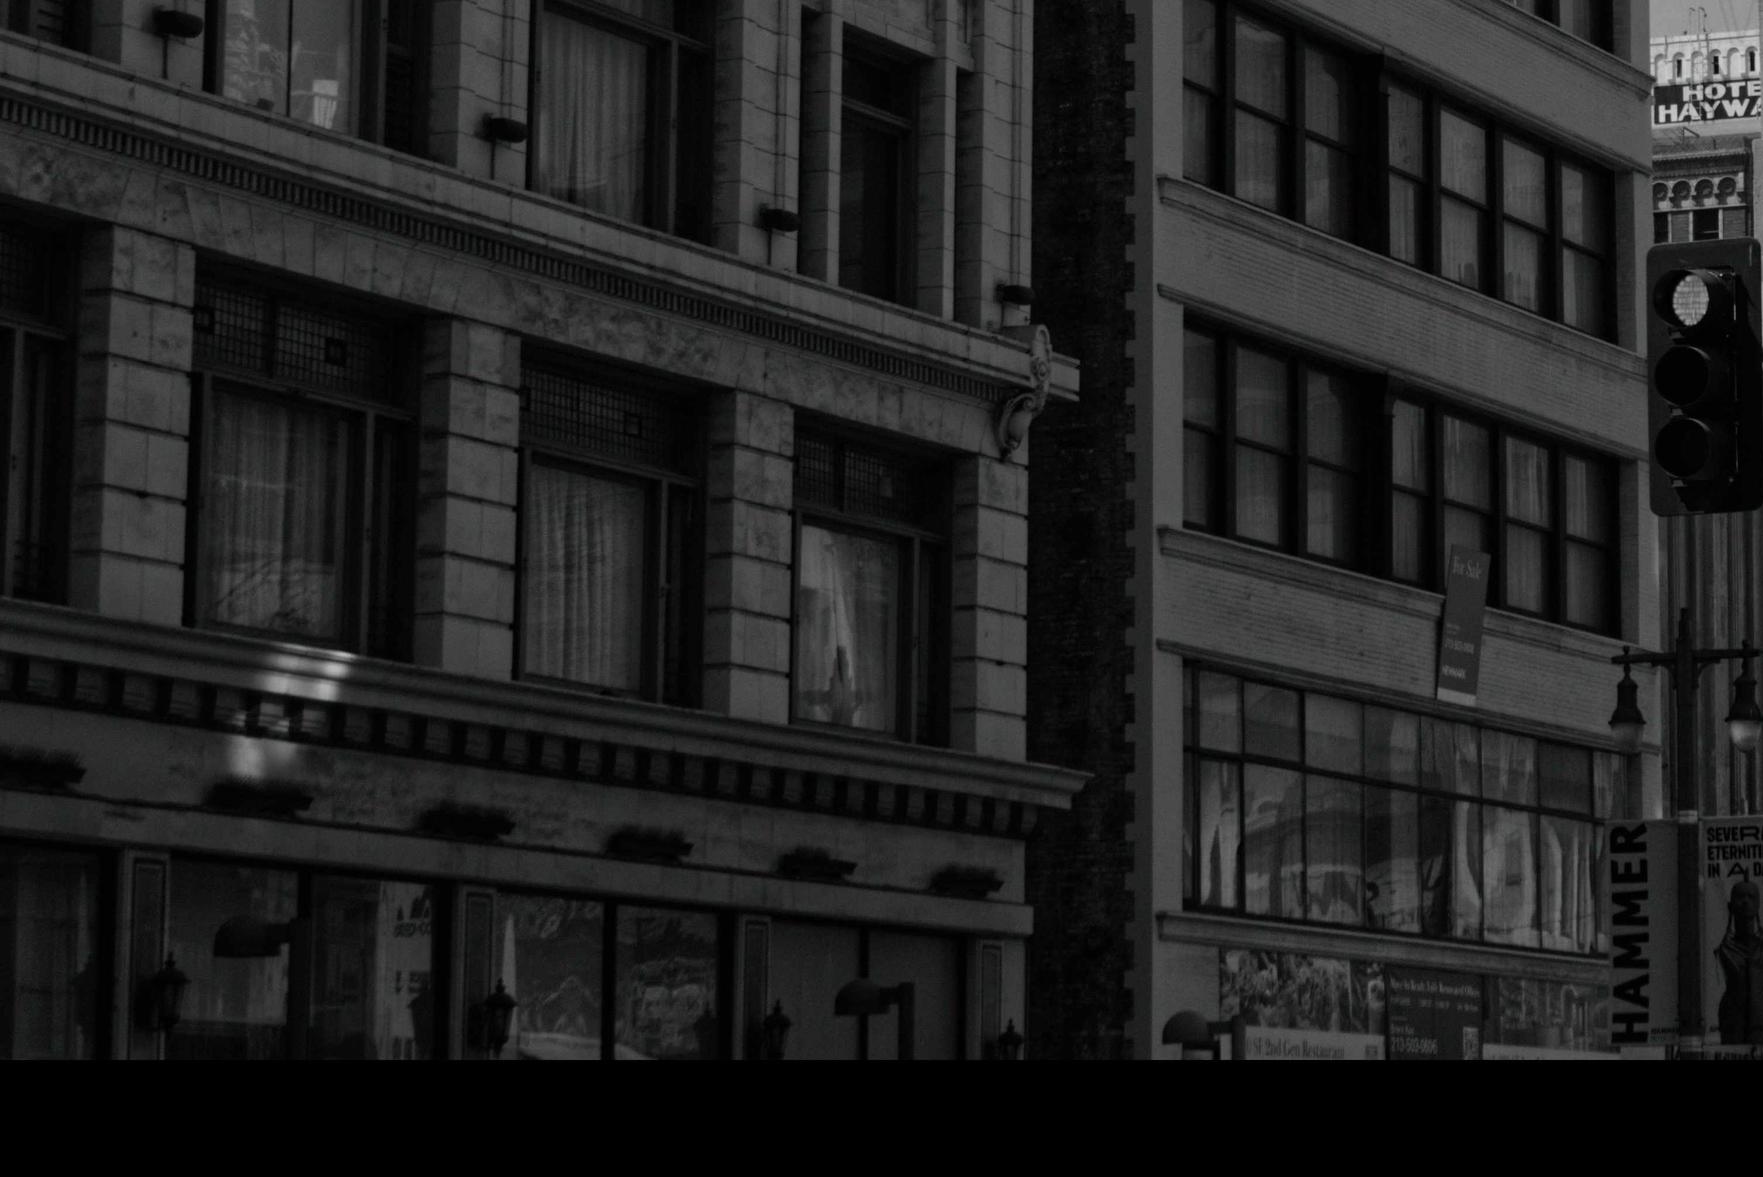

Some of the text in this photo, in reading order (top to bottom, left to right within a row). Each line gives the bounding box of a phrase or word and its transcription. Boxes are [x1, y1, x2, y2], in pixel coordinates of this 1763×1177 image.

[1708, 862, 1720, 877] IN
[1727, 862, 1748, 877] A
[1610, 824, 1649, 1044] HAMMER
